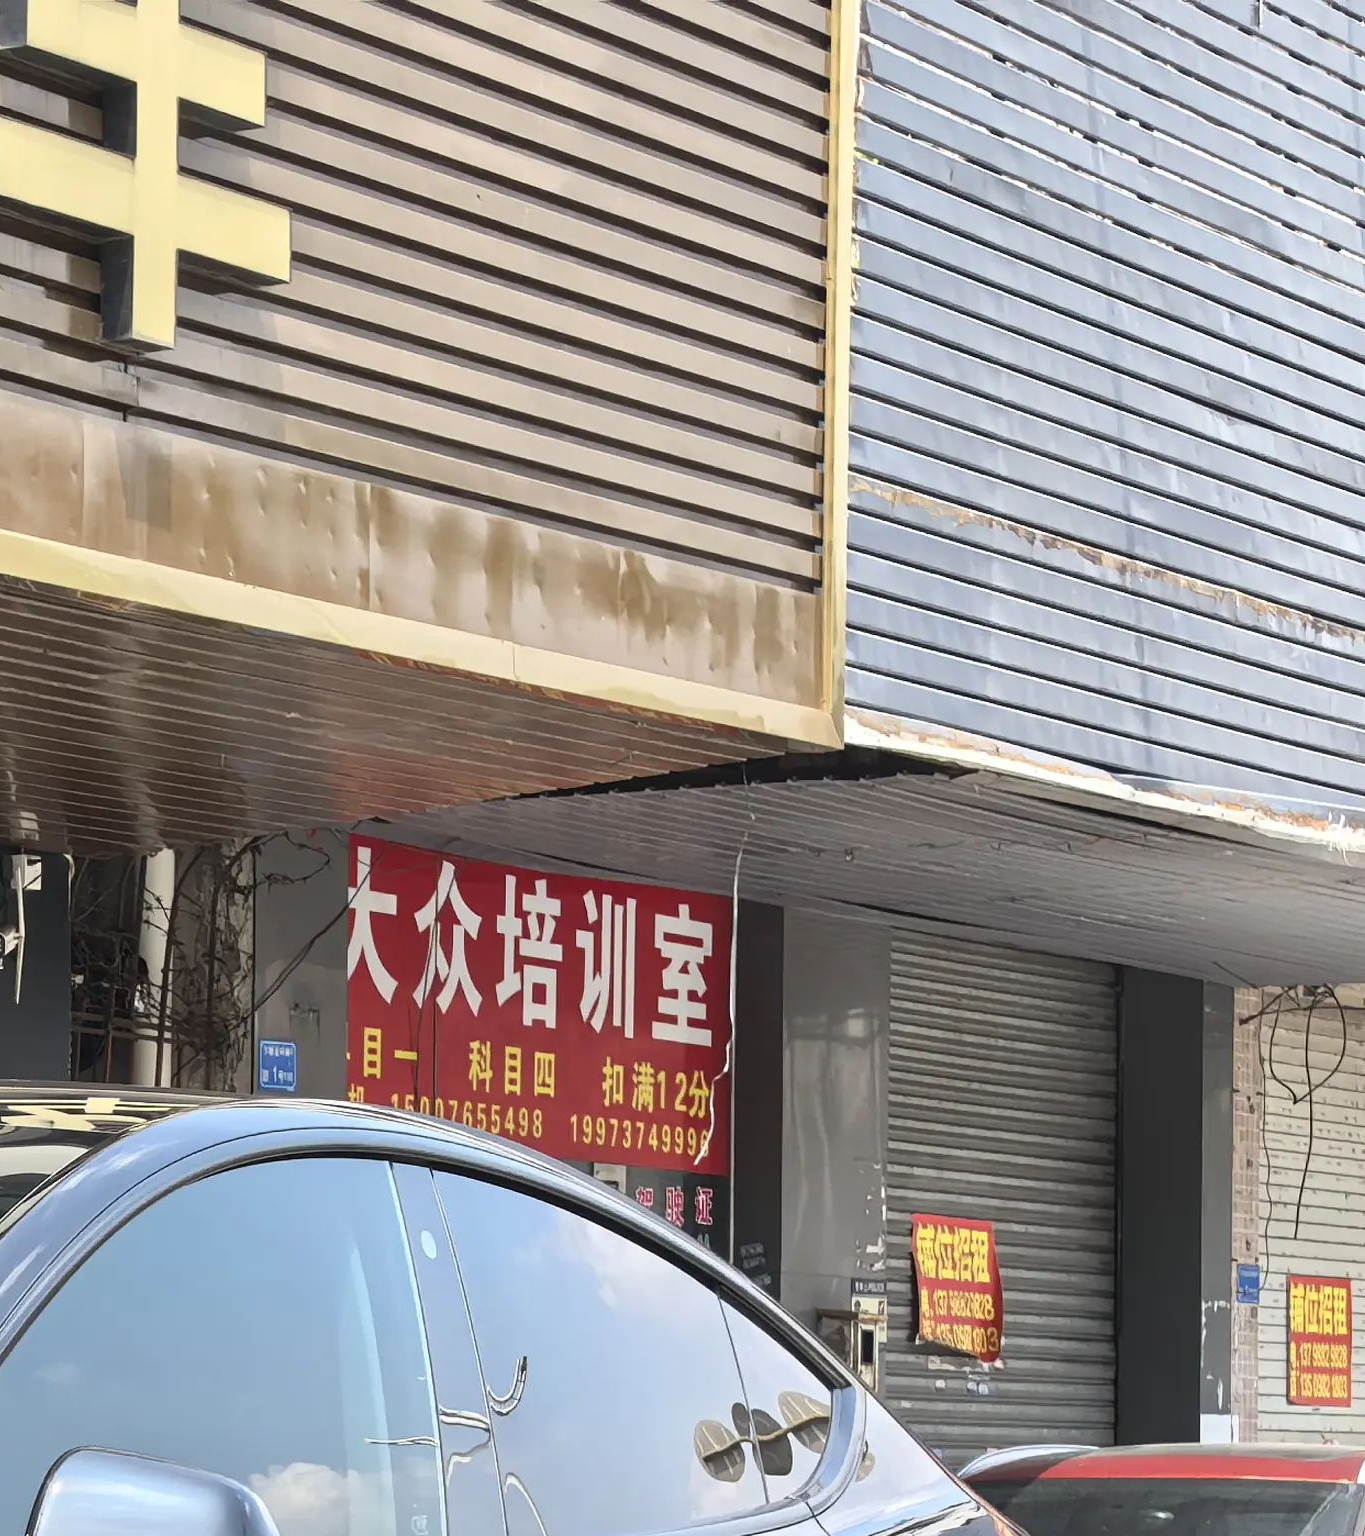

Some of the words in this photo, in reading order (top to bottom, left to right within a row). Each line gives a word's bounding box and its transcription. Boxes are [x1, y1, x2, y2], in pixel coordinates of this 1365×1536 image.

[348, 846, 713, 1047] 大众培训室
[347, 1027, 418, 1079] 目一
[468, 1039, 556, 1098] 科目四
[602, 1056, 710, 1119] 扣满12分
